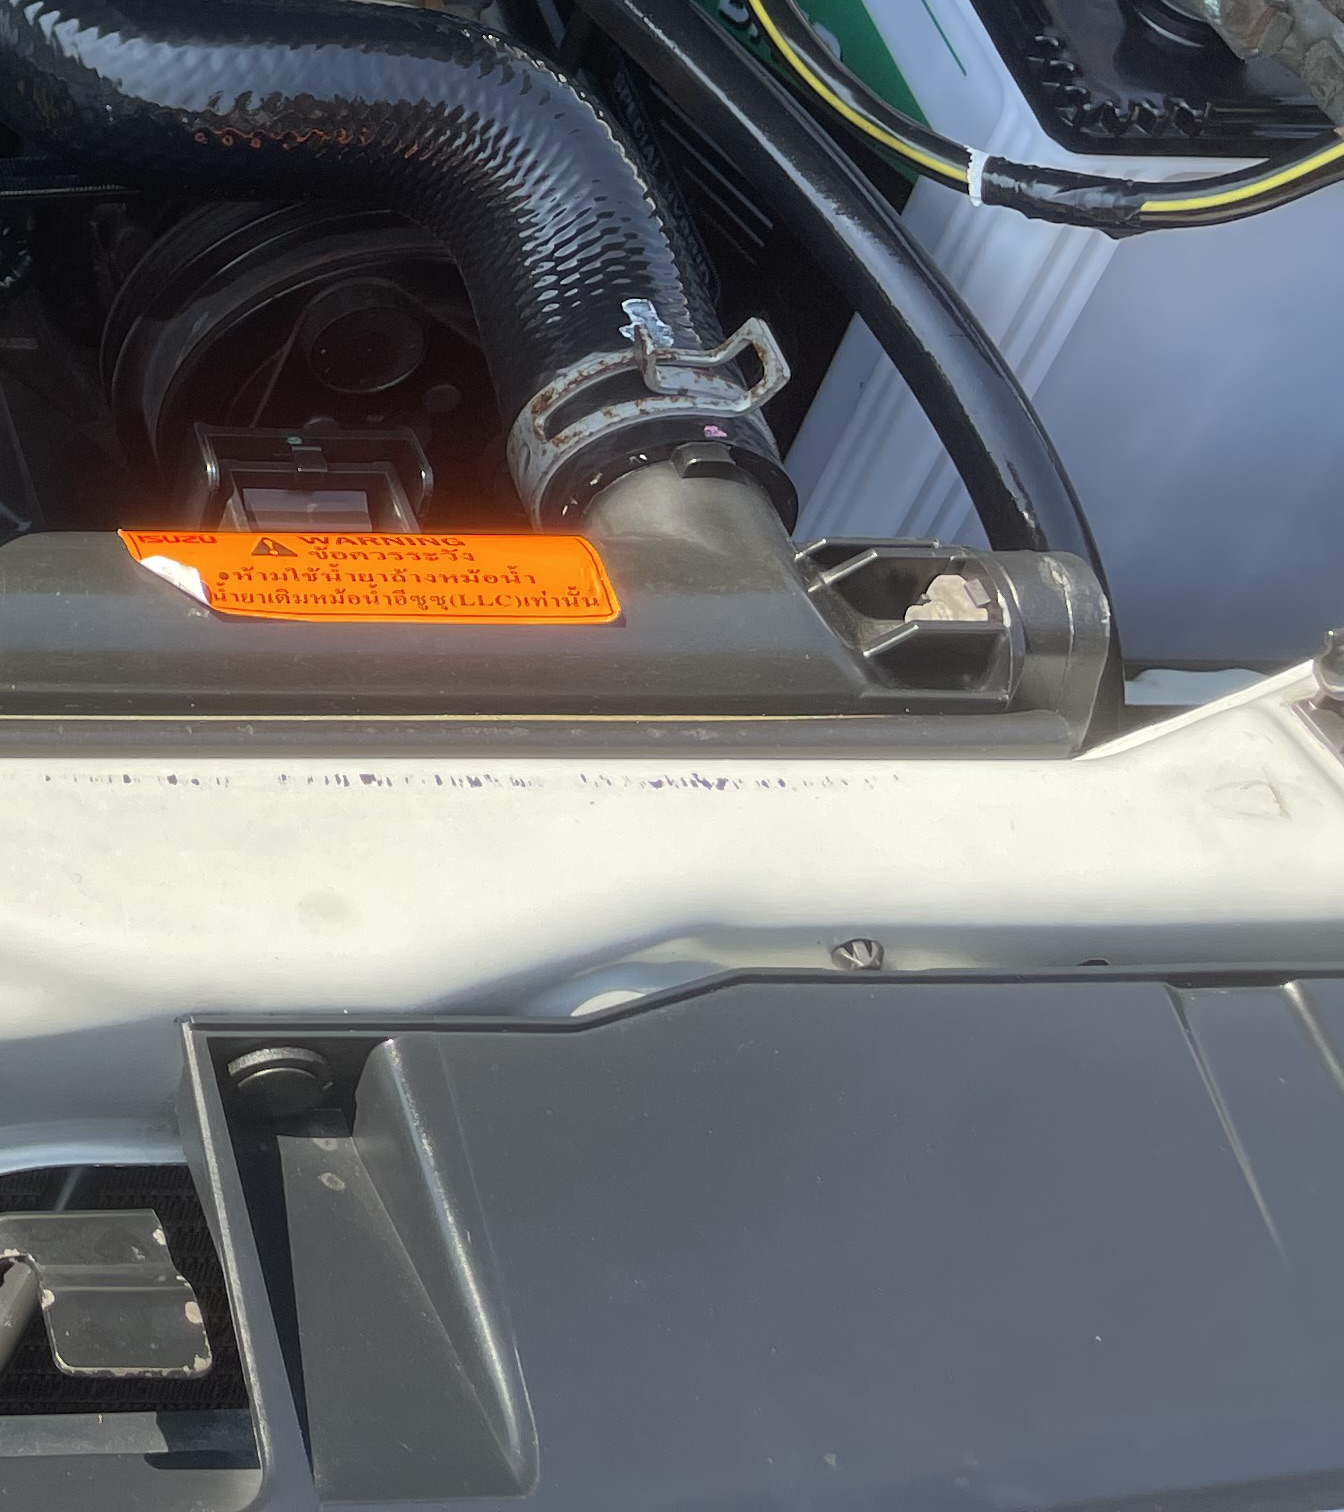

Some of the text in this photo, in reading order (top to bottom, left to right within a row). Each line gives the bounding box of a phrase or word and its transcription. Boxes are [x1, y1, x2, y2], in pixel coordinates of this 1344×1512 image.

[138, 535, 217, 544] ISUZU
[297, 535, 466, 547] WARNING
[308, 546, 476, 562] ข้อควรระวัง
